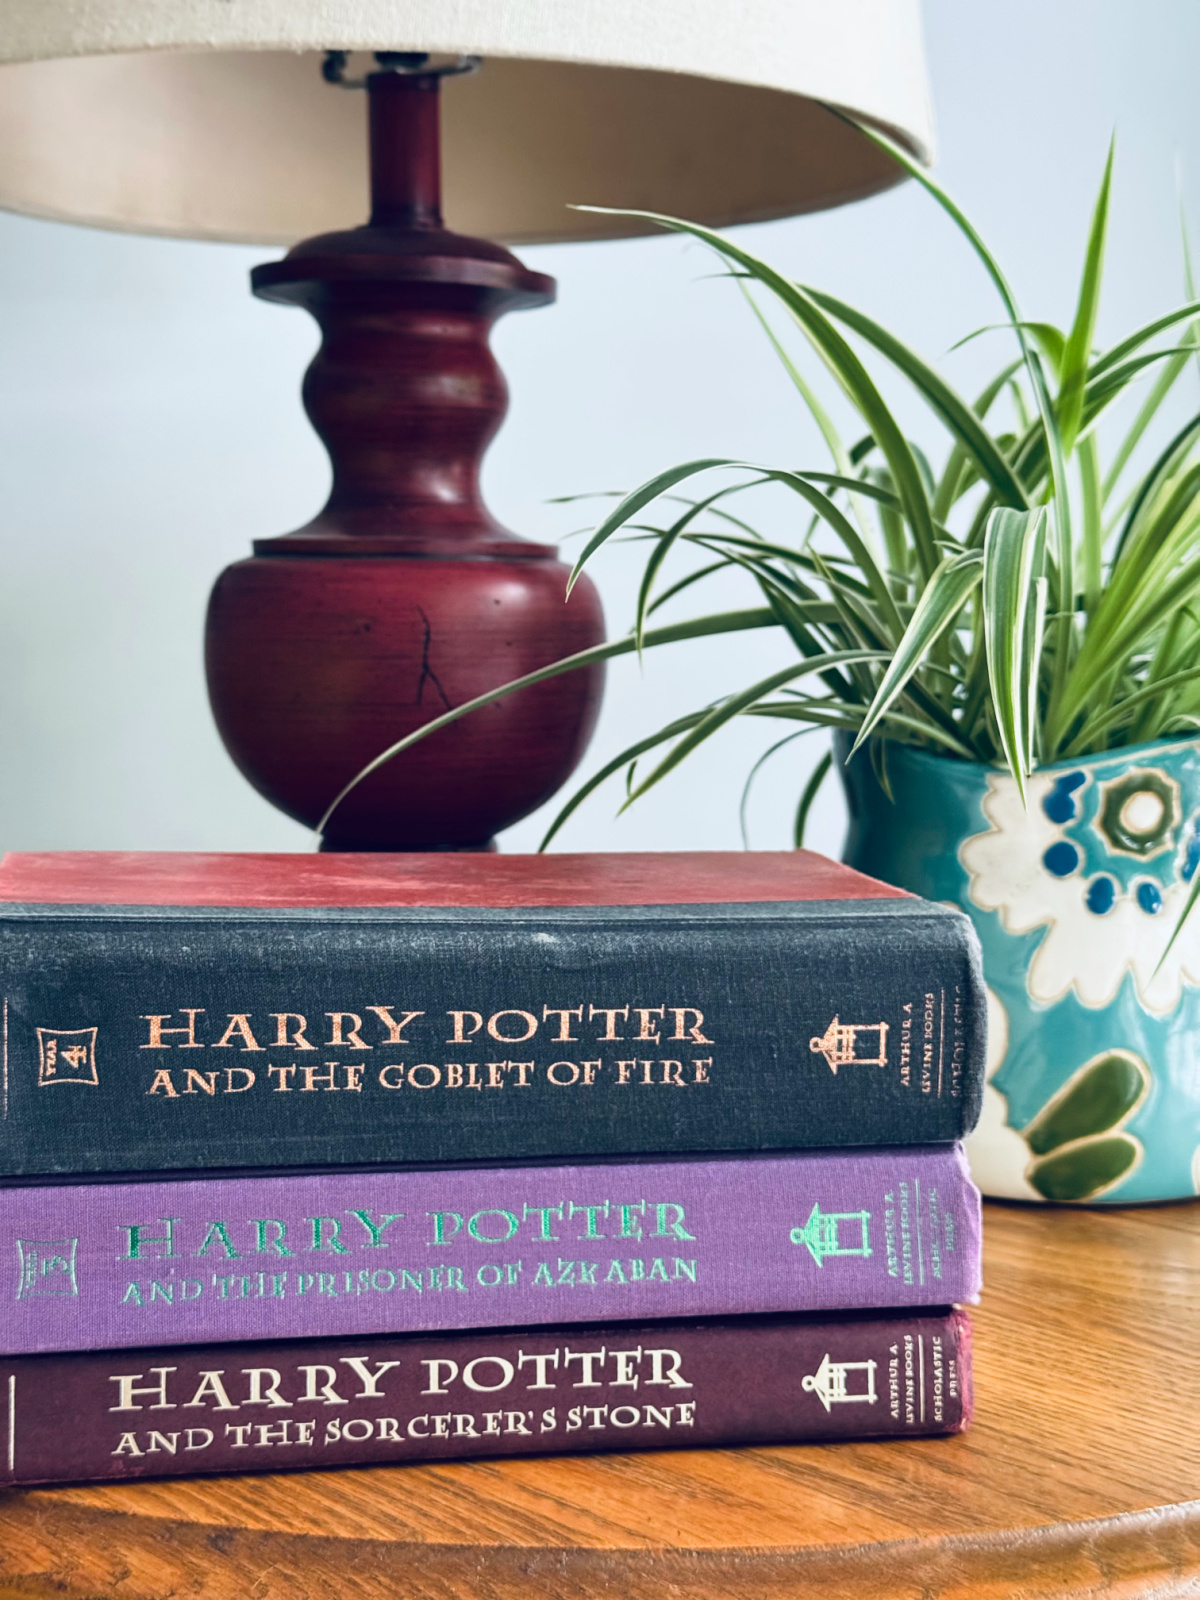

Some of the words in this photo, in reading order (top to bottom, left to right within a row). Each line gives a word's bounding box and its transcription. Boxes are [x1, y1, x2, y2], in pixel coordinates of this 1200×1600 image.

[140, 1005, 426, 1051] HARRY
[446, 1003, 716, 1046] POTTER
[924, 992, 935, 1039] BOOKS
[45, 1038, 58, 1077] YEAR
[60, 1044, 88, 1069] 4
[145, 1067, 256, 1098] AND
[267, 1061, 367, 1093] THE
[378, 1060, 535, 1091] GOBLET
[546, 1057, 602, 1086] OF
[614, 1056, 714, 1087] FIRE
[900, 1017, 913, 1087] ARTHUR
[922, 1042, 934, 1094] LEVINE
[115, 1209, 405, 1260] HARRY
[426, 1199, 697, 1246] POTTER
[885, 1209, 898, 1278] ARTHUR
[121, 1278, 205, 1306] AND
[211, 1270, 288, 1300] THE
[295, 1263, 469, 1298] PRISONER
[476, 1259, 523, 1287] OF
[531, 1256, 698, 1288] AZKABAN
[901, 1231, 914, 1285] LEVINE
[109, 1356, 400, 1412] HARRY
[420, 1345, 694, 1395] POTTER
[903, 1334, 915, 1378] BOOKS
[932, 1336, 944, 1423] SCHOLASTIC
[948, 1360, 958, 1398] PRESS
[889, 1358, 900, 1420] ARTHUR
[904, 1378, 915, 1425] LEVINE
[111, 1428, 215, 1457] AND
[225, 1419, 317, 1447] THE
[324, 1405, 557, 1447] SORCERER'S
[566, 1400, 697, 1433] STONE
